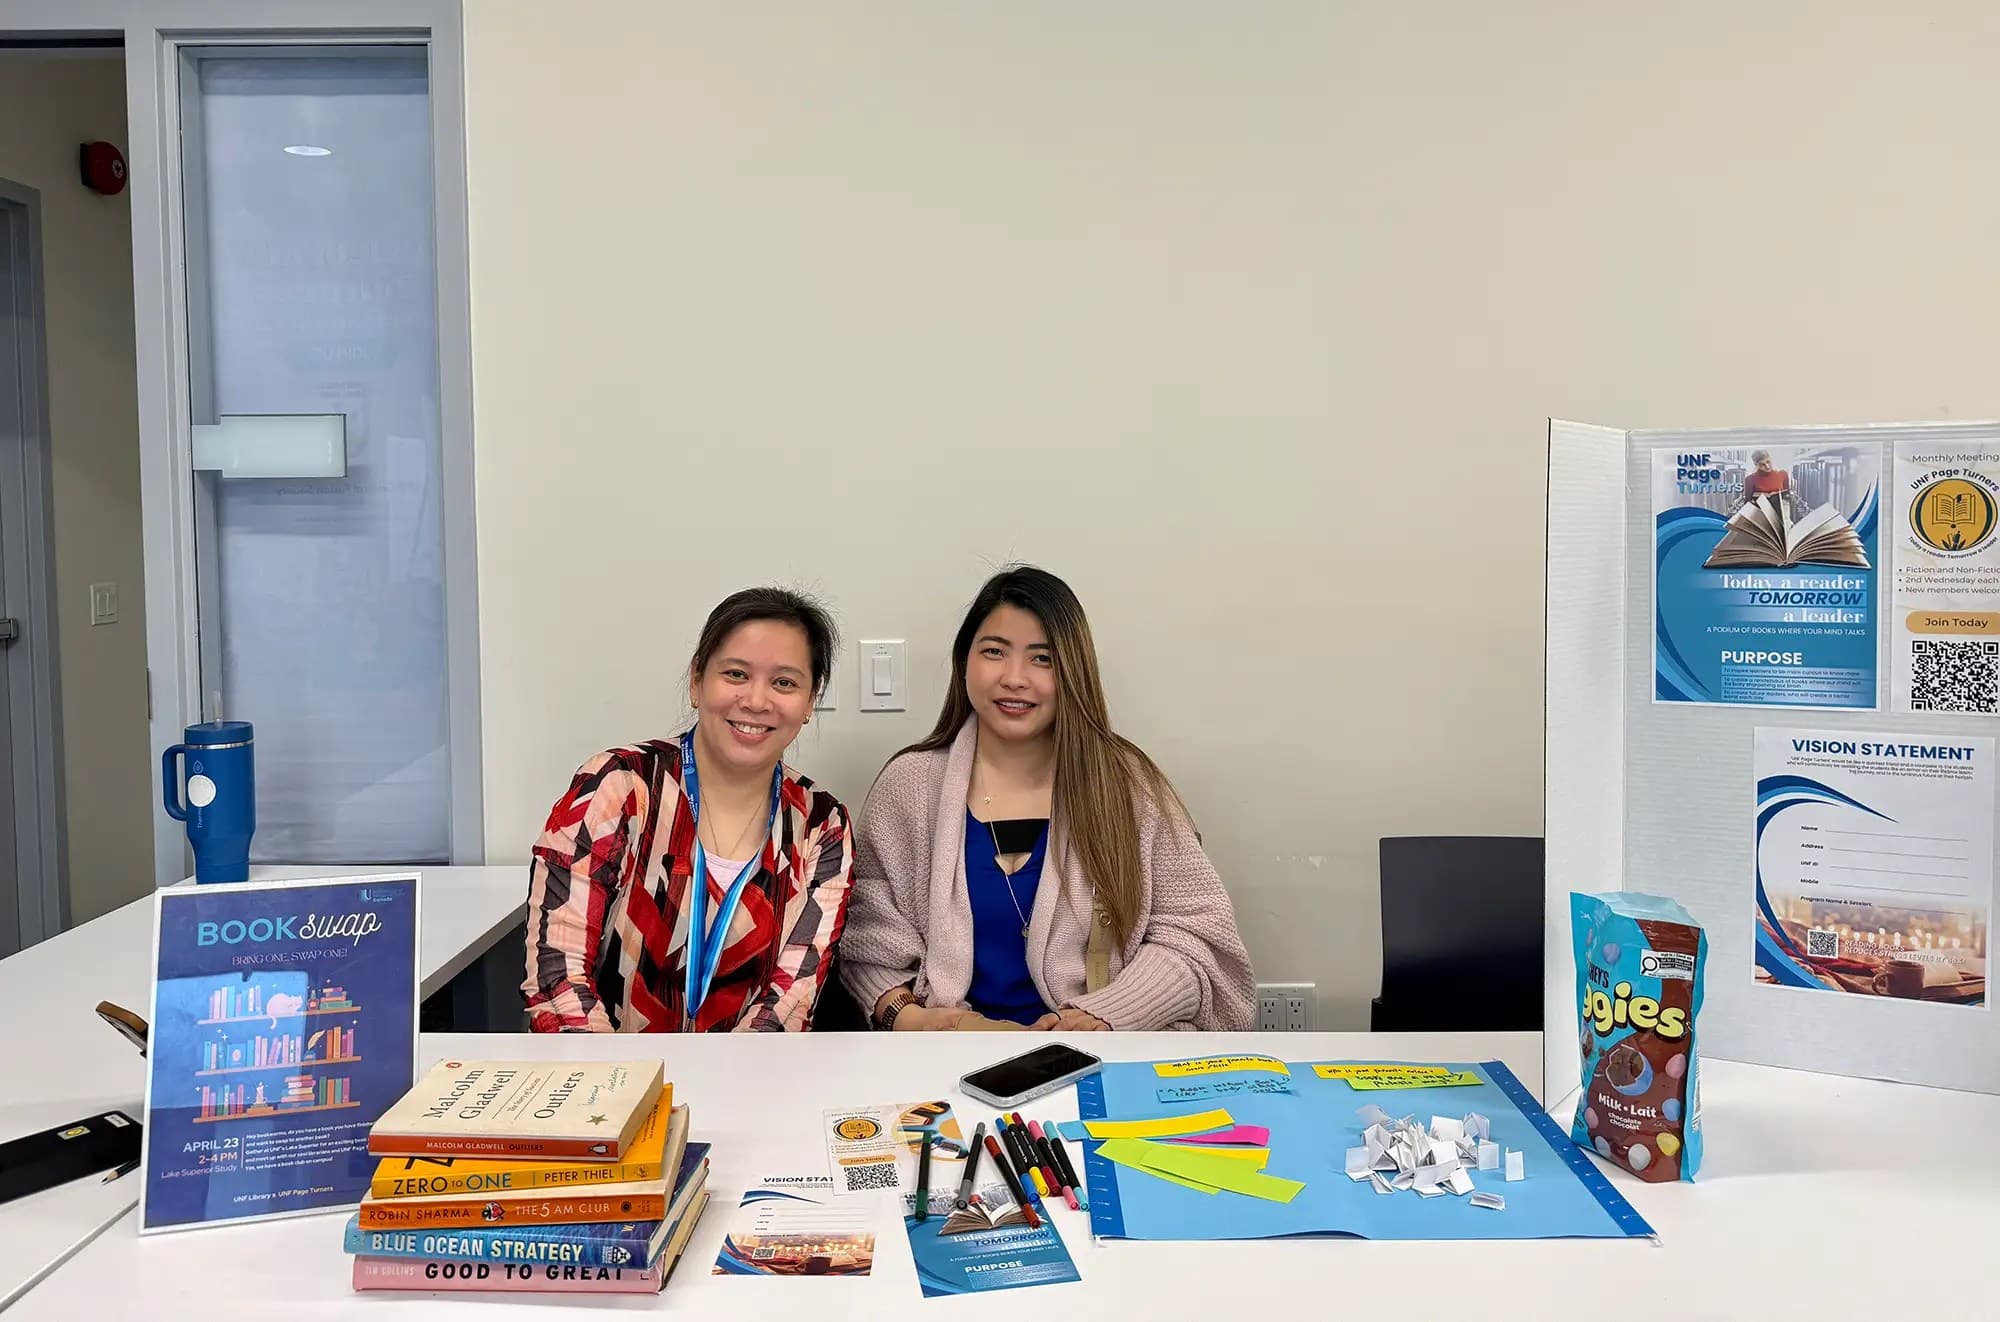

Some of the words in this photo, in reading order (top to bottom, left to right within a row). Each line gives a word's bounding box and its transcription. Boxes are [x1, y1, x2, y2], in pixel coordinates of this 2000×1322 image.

[1677, 454, 1711, 467] UNF
[1912, 454, 1954, 463] Monthly
[1677, 468, 1721, 483] Page
[1910, 473, 1931, 490] UNF
[1931, 468, 1960, 479] Page
[1962, 468, 2000, 492] Turners
[1677, 481, 1744, 495] Turners
[1720, 574, 1771, 591] Today
[1781, 577, 1791, 589] a
[1799, 574, 1864, 590] reader
[1924, 576, 1975, 584] Wednesday
[1749, 591, 1864, 605] TOMORROW
[1784, 611, 1794, 623] a
[1802, 608, 1864, 623] leader
[1925, 617, 1949, 626] Join
[1952, 618, 1988, 628] Today
[1721, 650, 1803, 665] PURPOSE
[1792, 739, 1856, 755] VISION
[1861, 742, 1975, 761] STATEMENT
[197, 916, 298, 946] BOOK
[299, 912, 382, 947] swap
[232, 951, 264, 966] BRING
[291, 949, 322, 961] SWAP
[421, 1069, 485, 1119] Malcolm
[458, 1069, 519, 1120] Gladwell
[533, 1071, 585, 1119] Outliers
[1598, 1092, 1622, 1112] Milk
[1630, 1104, 1657, 1118] Lait
[1608, 1112, 1642, 1125] chocolate
[1609, 1118, 1640, 1130] chocolat
[183, 1139, 222, 1152] APRIL
[223, 1137, 239, 1148] 23
[465, 1142, 504, 1150] GLADWELL
[220, 1151, 238, 1161] PM
[161, 1171, 180, 1179] Lake
[180, 1166, 213, 1177] Superior
[214, 1164, 238, 1173] Study
[393, 1176, 448, 1195] ZERO
[452, 1180, 463, 1188] TO
[466, 1173, 513, 1190] ONE
[544, 1171, 578, 1183] PETER
[584, 1169, 614, 1180] THIEL
[248, 1192, 271, 1201] Library
[293, 1188, 309, 1196] Page
[370, 1210, 411, 1221] ROBIN
[416, 1208, 471, 1220] SHARMA
[516, 1205, 537, 1216] THE
[540, 1202, 550, 1217] 5
[554, 1205, 574, 1214] AM
[579, 1203, 610, 1214] CLUB
[975, 1232, 1049, 1246] TOMORROW
[372, 1233, 417, 1252] BLUE
[424, 1236, 484, 1256] OCEAN
[491, 1239, 584, 1262] STRATEGY
[425, 1263, 490, 1280] GOOD
[504, 1264, 533, 1280] TO
[964, 1260, 1024, 1273] PURPOSE
